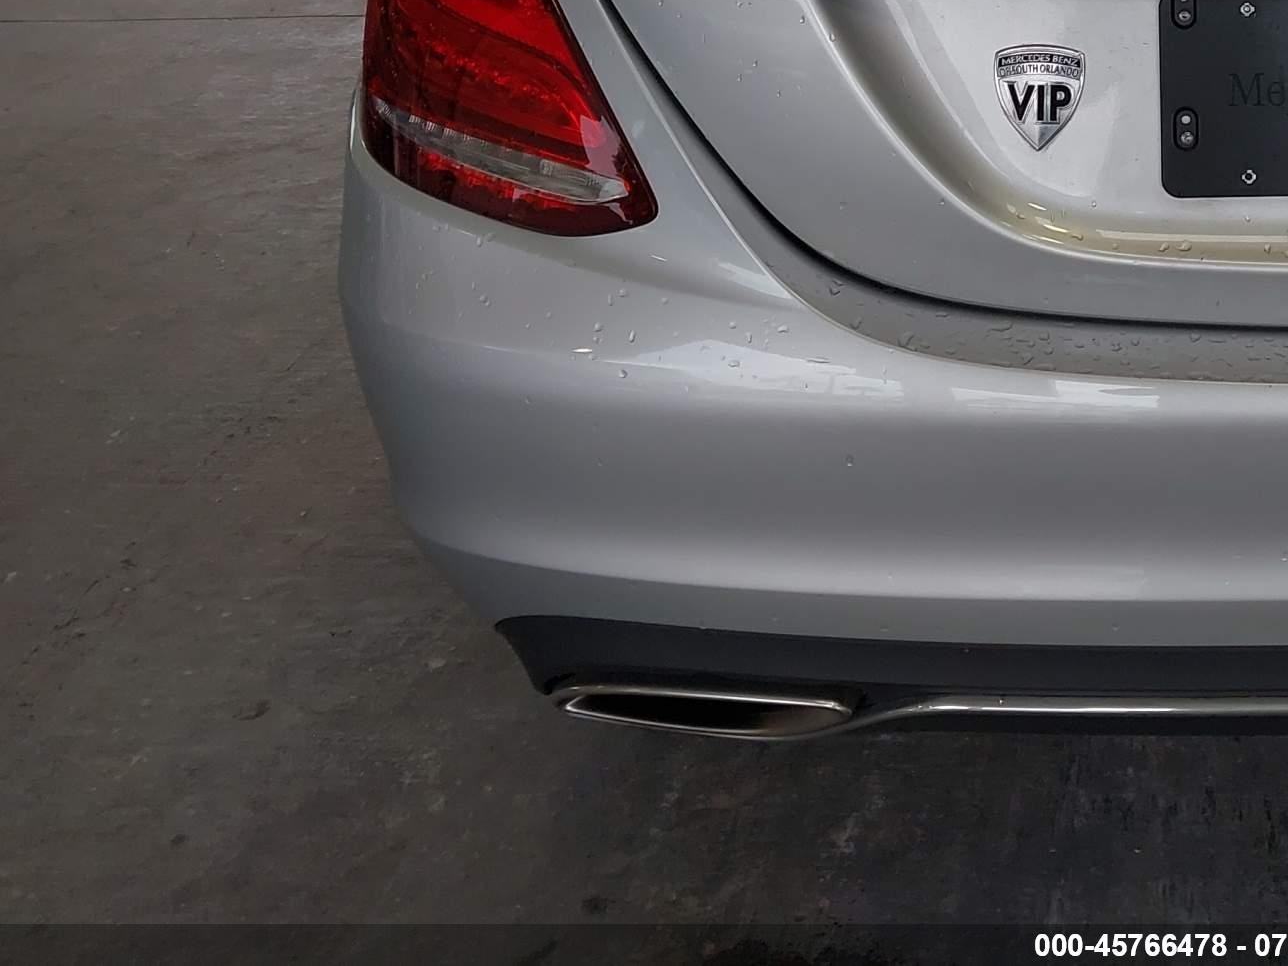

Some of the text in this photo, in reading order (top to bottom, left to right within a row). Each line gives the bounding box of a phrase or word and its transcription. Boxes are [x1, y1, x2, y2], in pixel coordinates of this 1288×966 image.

[1001, 54, 1079, 66] MERCEDES BENZ
[1010, 64, 1039, 75] SOUTH
[1039, 64, 1079, 77] ORLANDO
[1005, 83, 1073, 122] VIP
